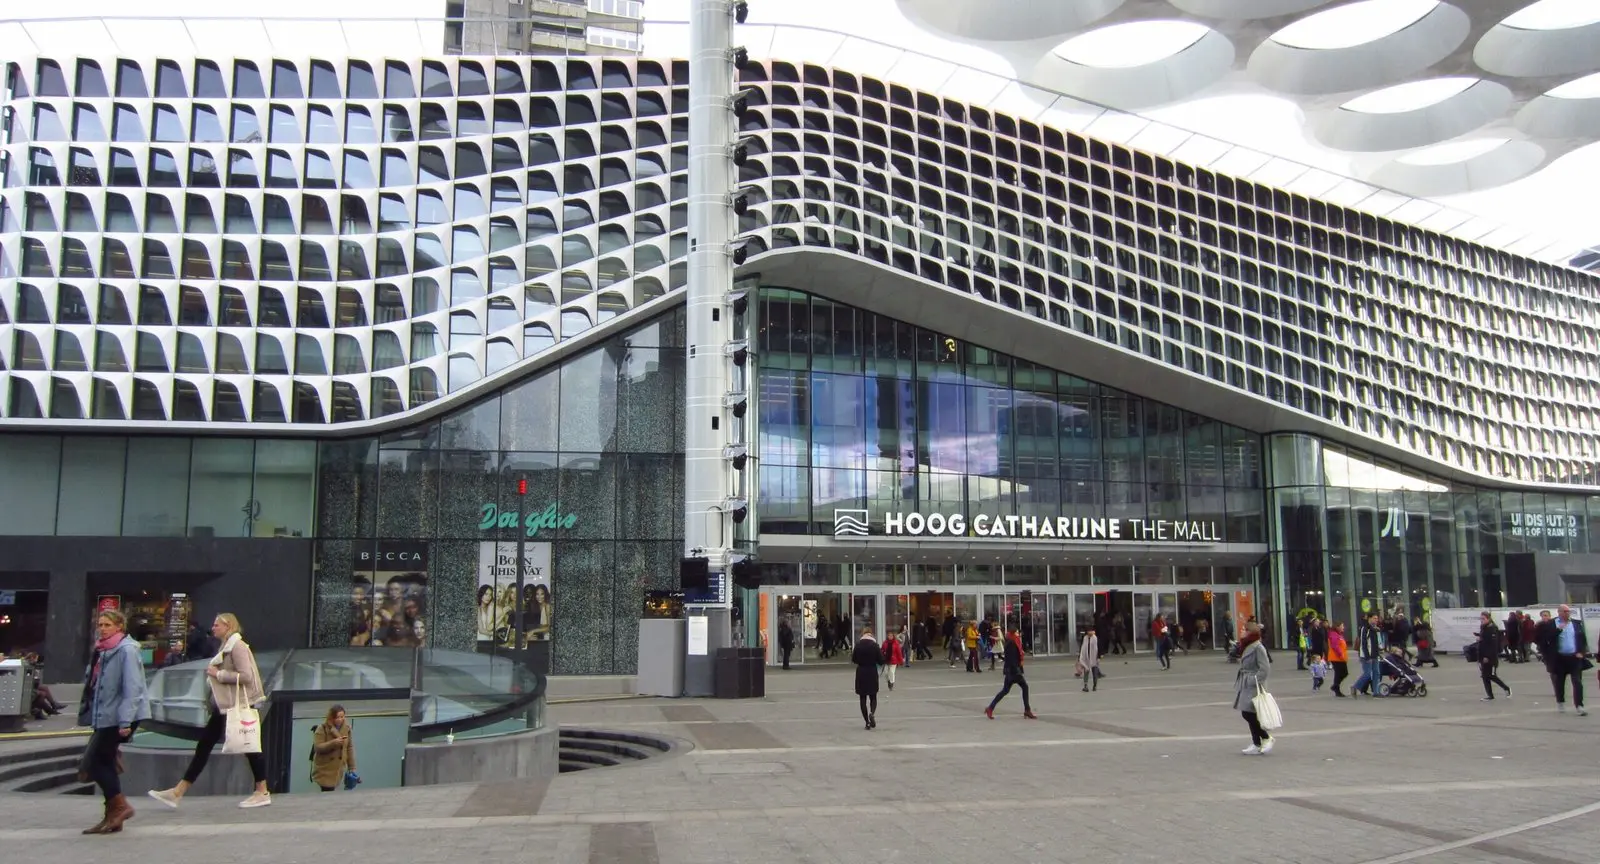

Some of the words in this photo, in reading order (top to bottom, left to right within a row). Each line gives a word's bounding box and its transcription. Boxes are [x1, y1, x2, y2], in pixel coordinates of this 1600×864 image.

[478, 501, 578, 537] Douglas
[1381, 507, 1409, 537] JD
[885, 511, 966, 536] HOOG
[973, 514, 1121, 539] CATHARIJNE
[1128, 518, 1167, 540] THE
[1174, 520, 1221, 541] MALL
[1531, 527, 1541, 536] OF
[1541, 527, 1577, 538] RAINRS
[361, 551, 421, 561] BECCA
[499, 554, 532, 566] BON
[488, 565, 516, 576] THIS
